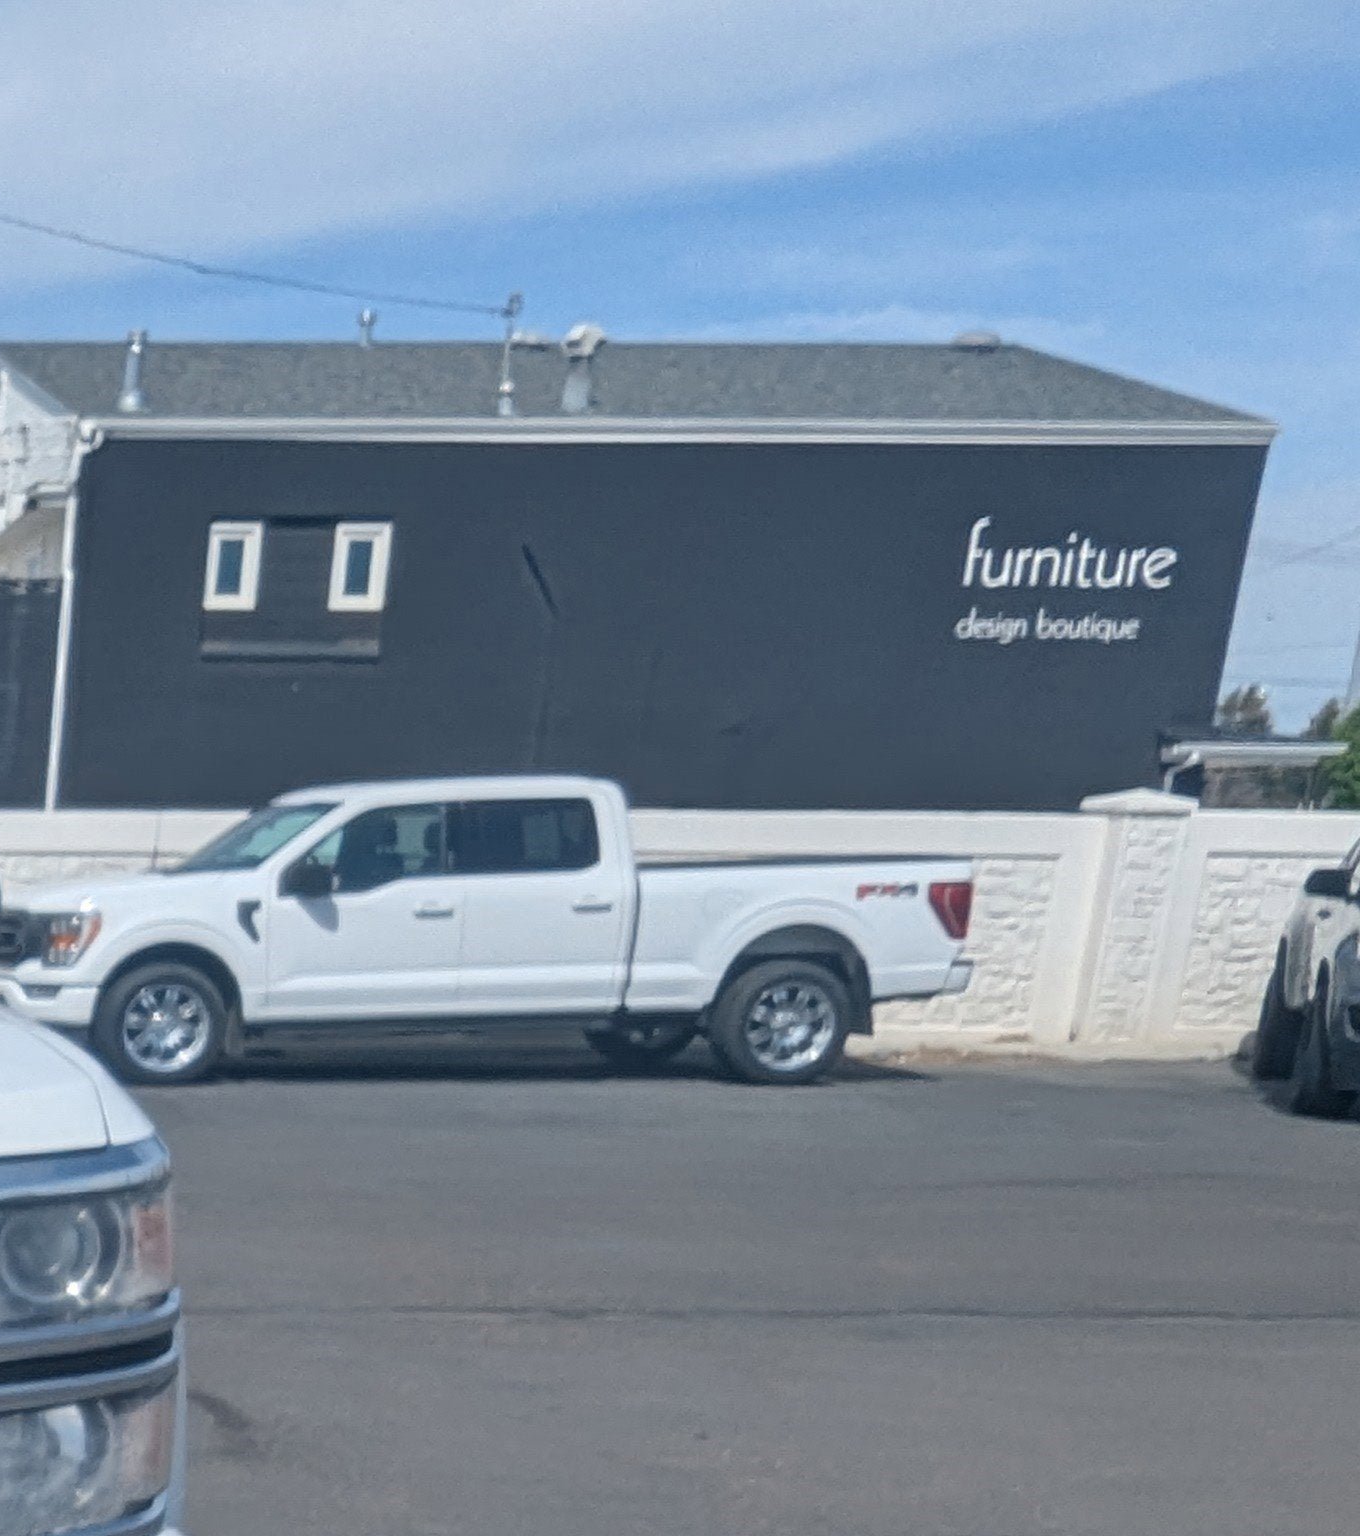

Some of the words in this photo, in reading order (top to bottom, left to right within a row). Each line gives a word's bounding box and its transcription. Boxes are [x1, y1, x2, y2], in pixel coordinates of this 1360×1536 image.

[961, 515, 1178, 588] furniture
[954, 607, 1028, 644] design
[1036, 608, 1141, 644] boutique
